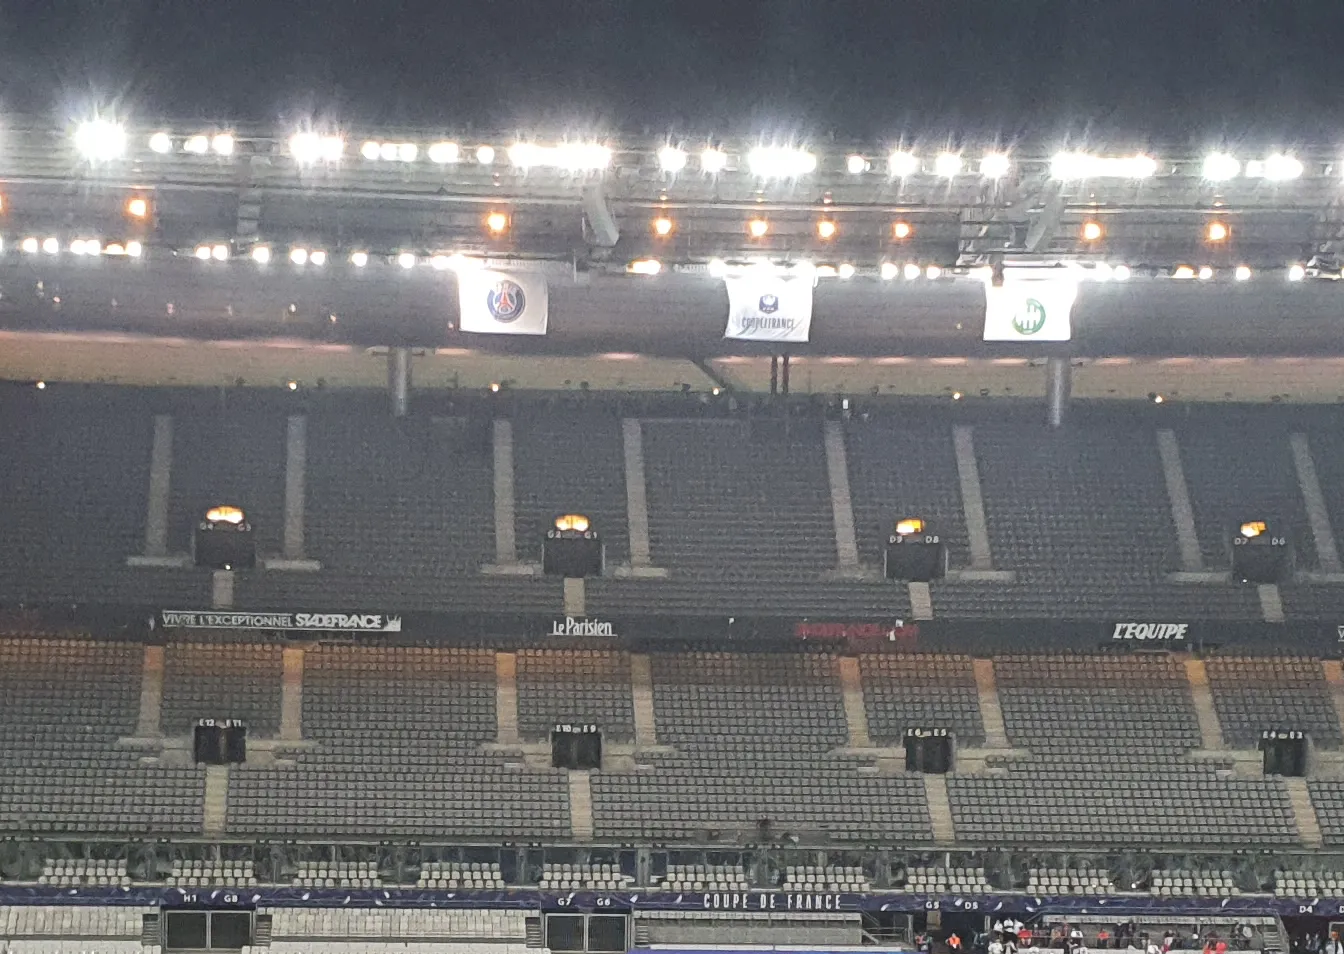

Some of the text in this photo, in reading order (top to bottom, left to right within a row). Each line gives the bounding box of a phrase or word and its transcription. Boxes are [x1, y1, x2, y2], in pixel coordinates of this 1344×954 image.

[703, 893, 841, 910] COUPE DE FRANCE
